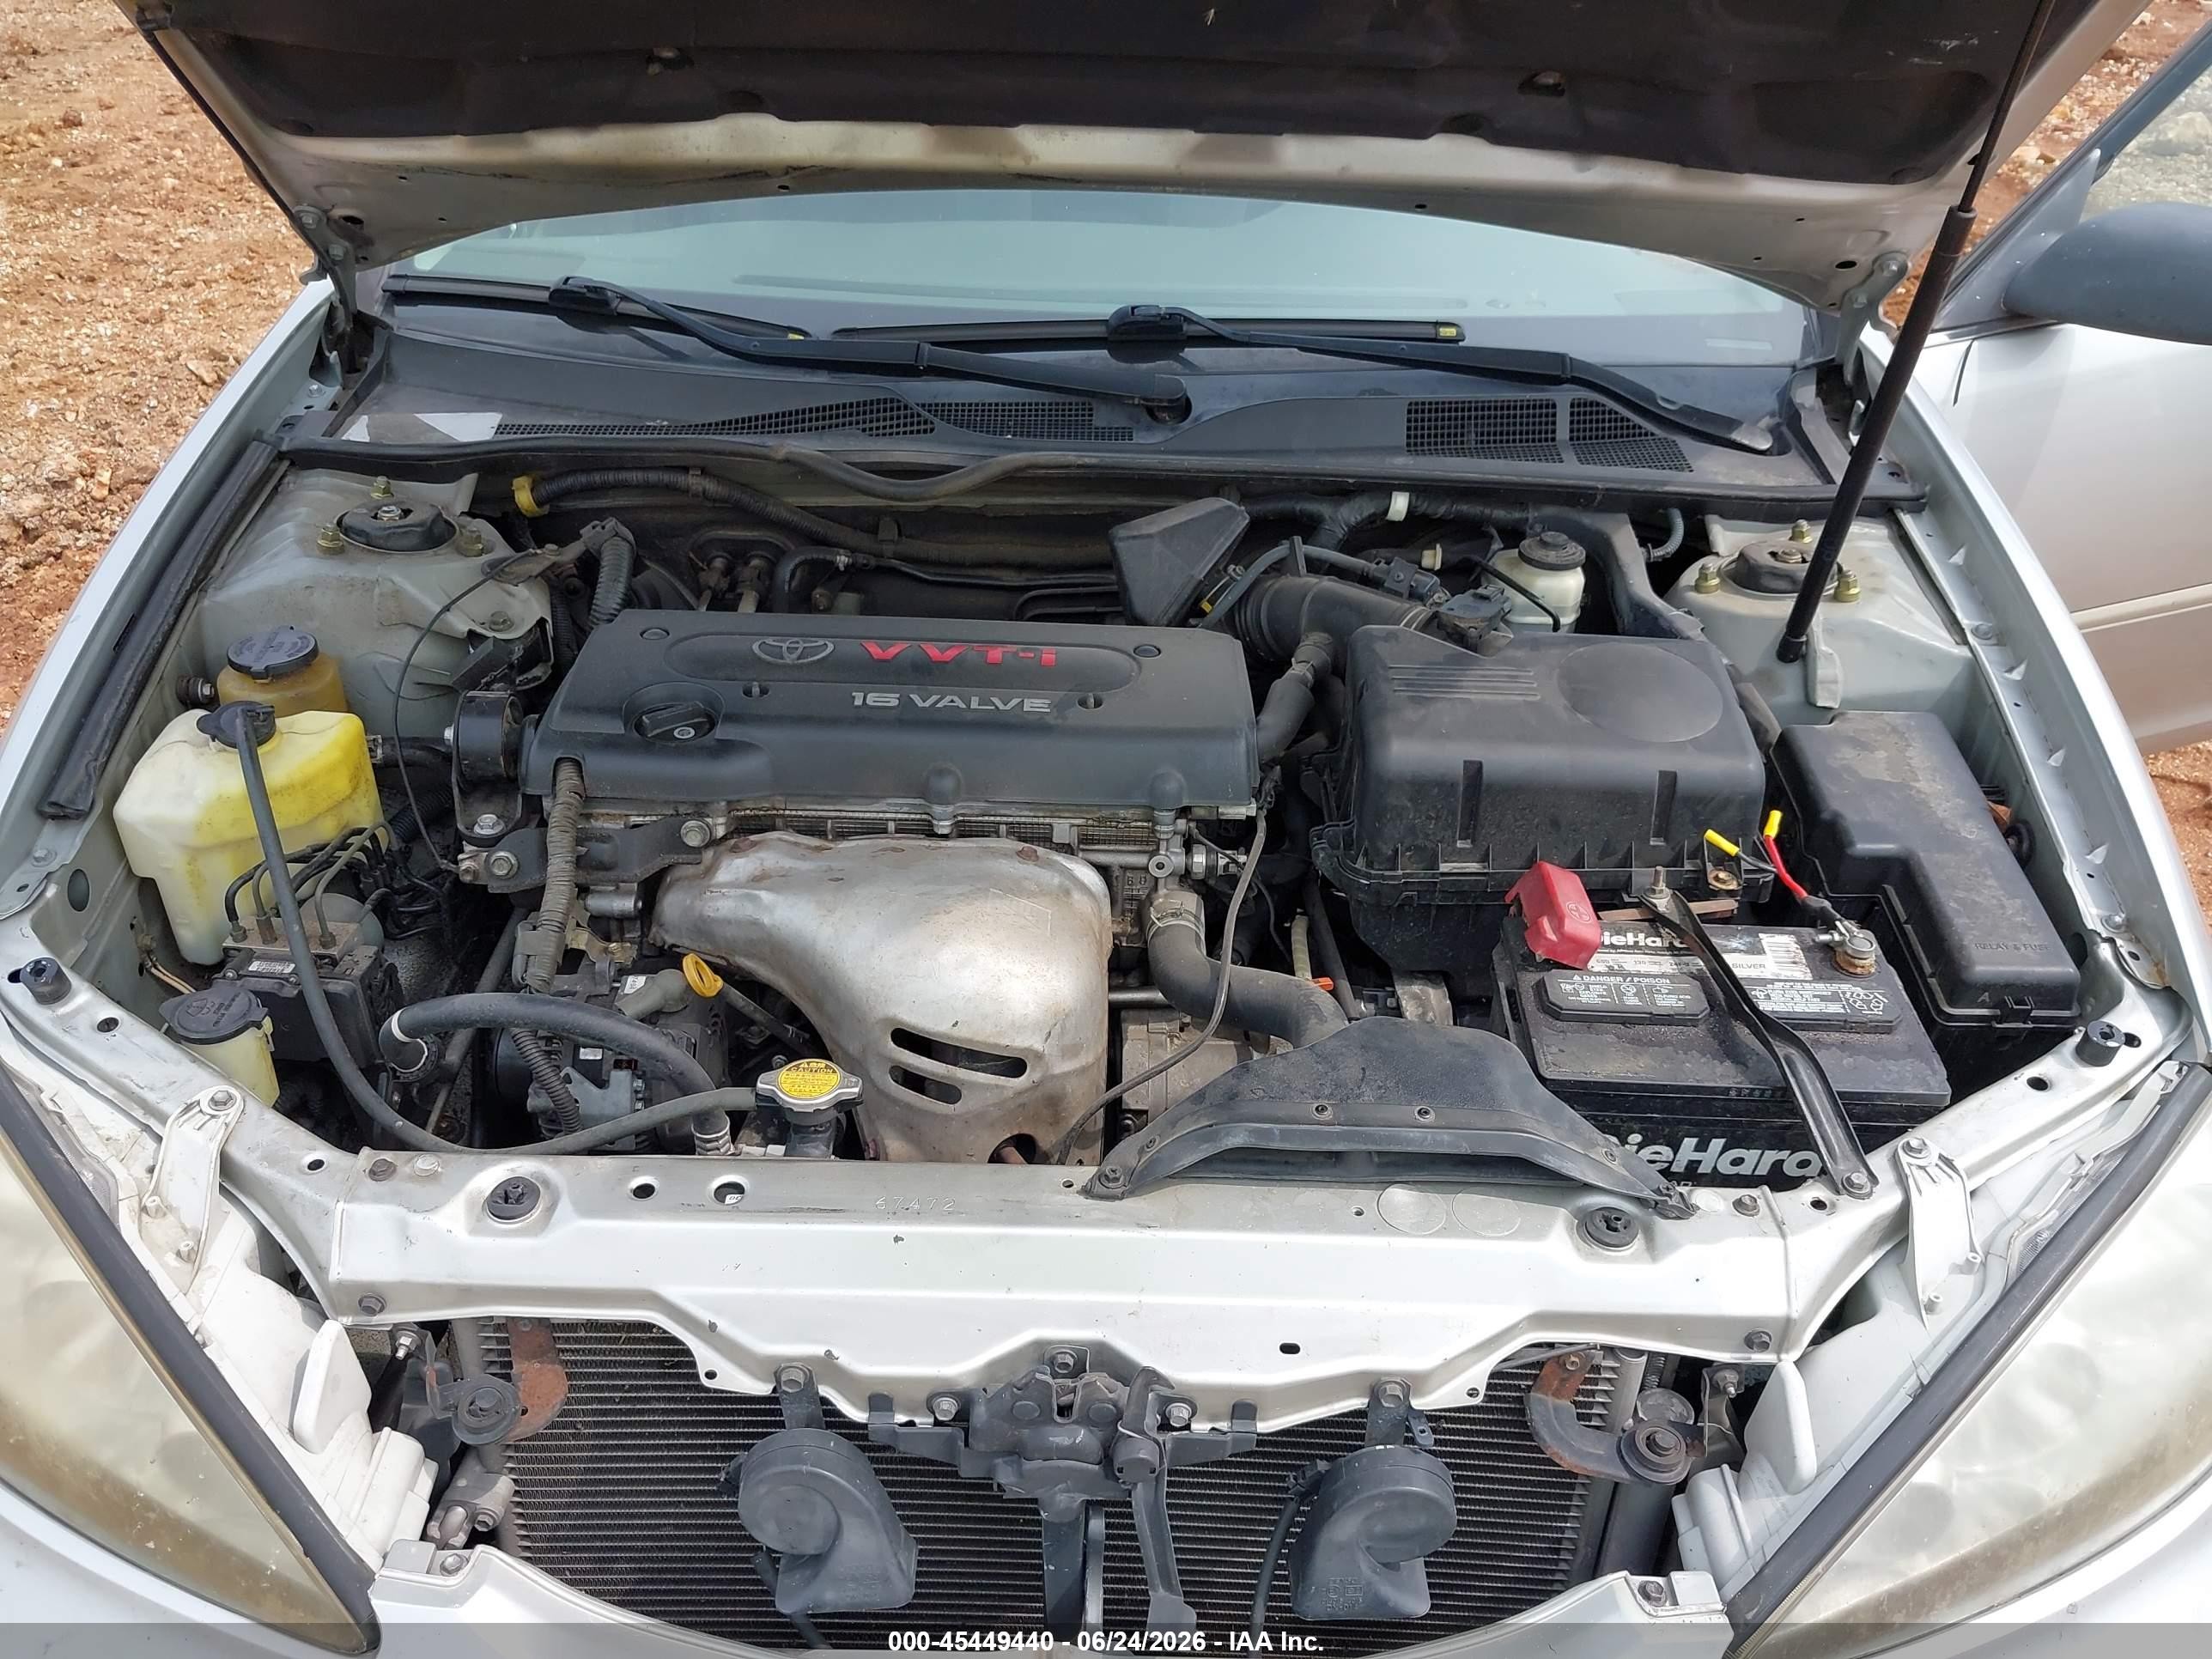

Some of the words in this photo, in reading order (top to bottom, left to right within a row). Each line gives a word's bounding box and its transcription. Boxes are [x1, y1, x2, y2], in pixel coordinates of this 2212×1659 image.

[851, 692, 901, 707] 16
[908, 694, 1052, 713] VALVE
[1601, 931, 1689, 947] ieHar
[1583, 975, 1624, 983] DANGER
[1633, 976, 1671, 985] POISON
